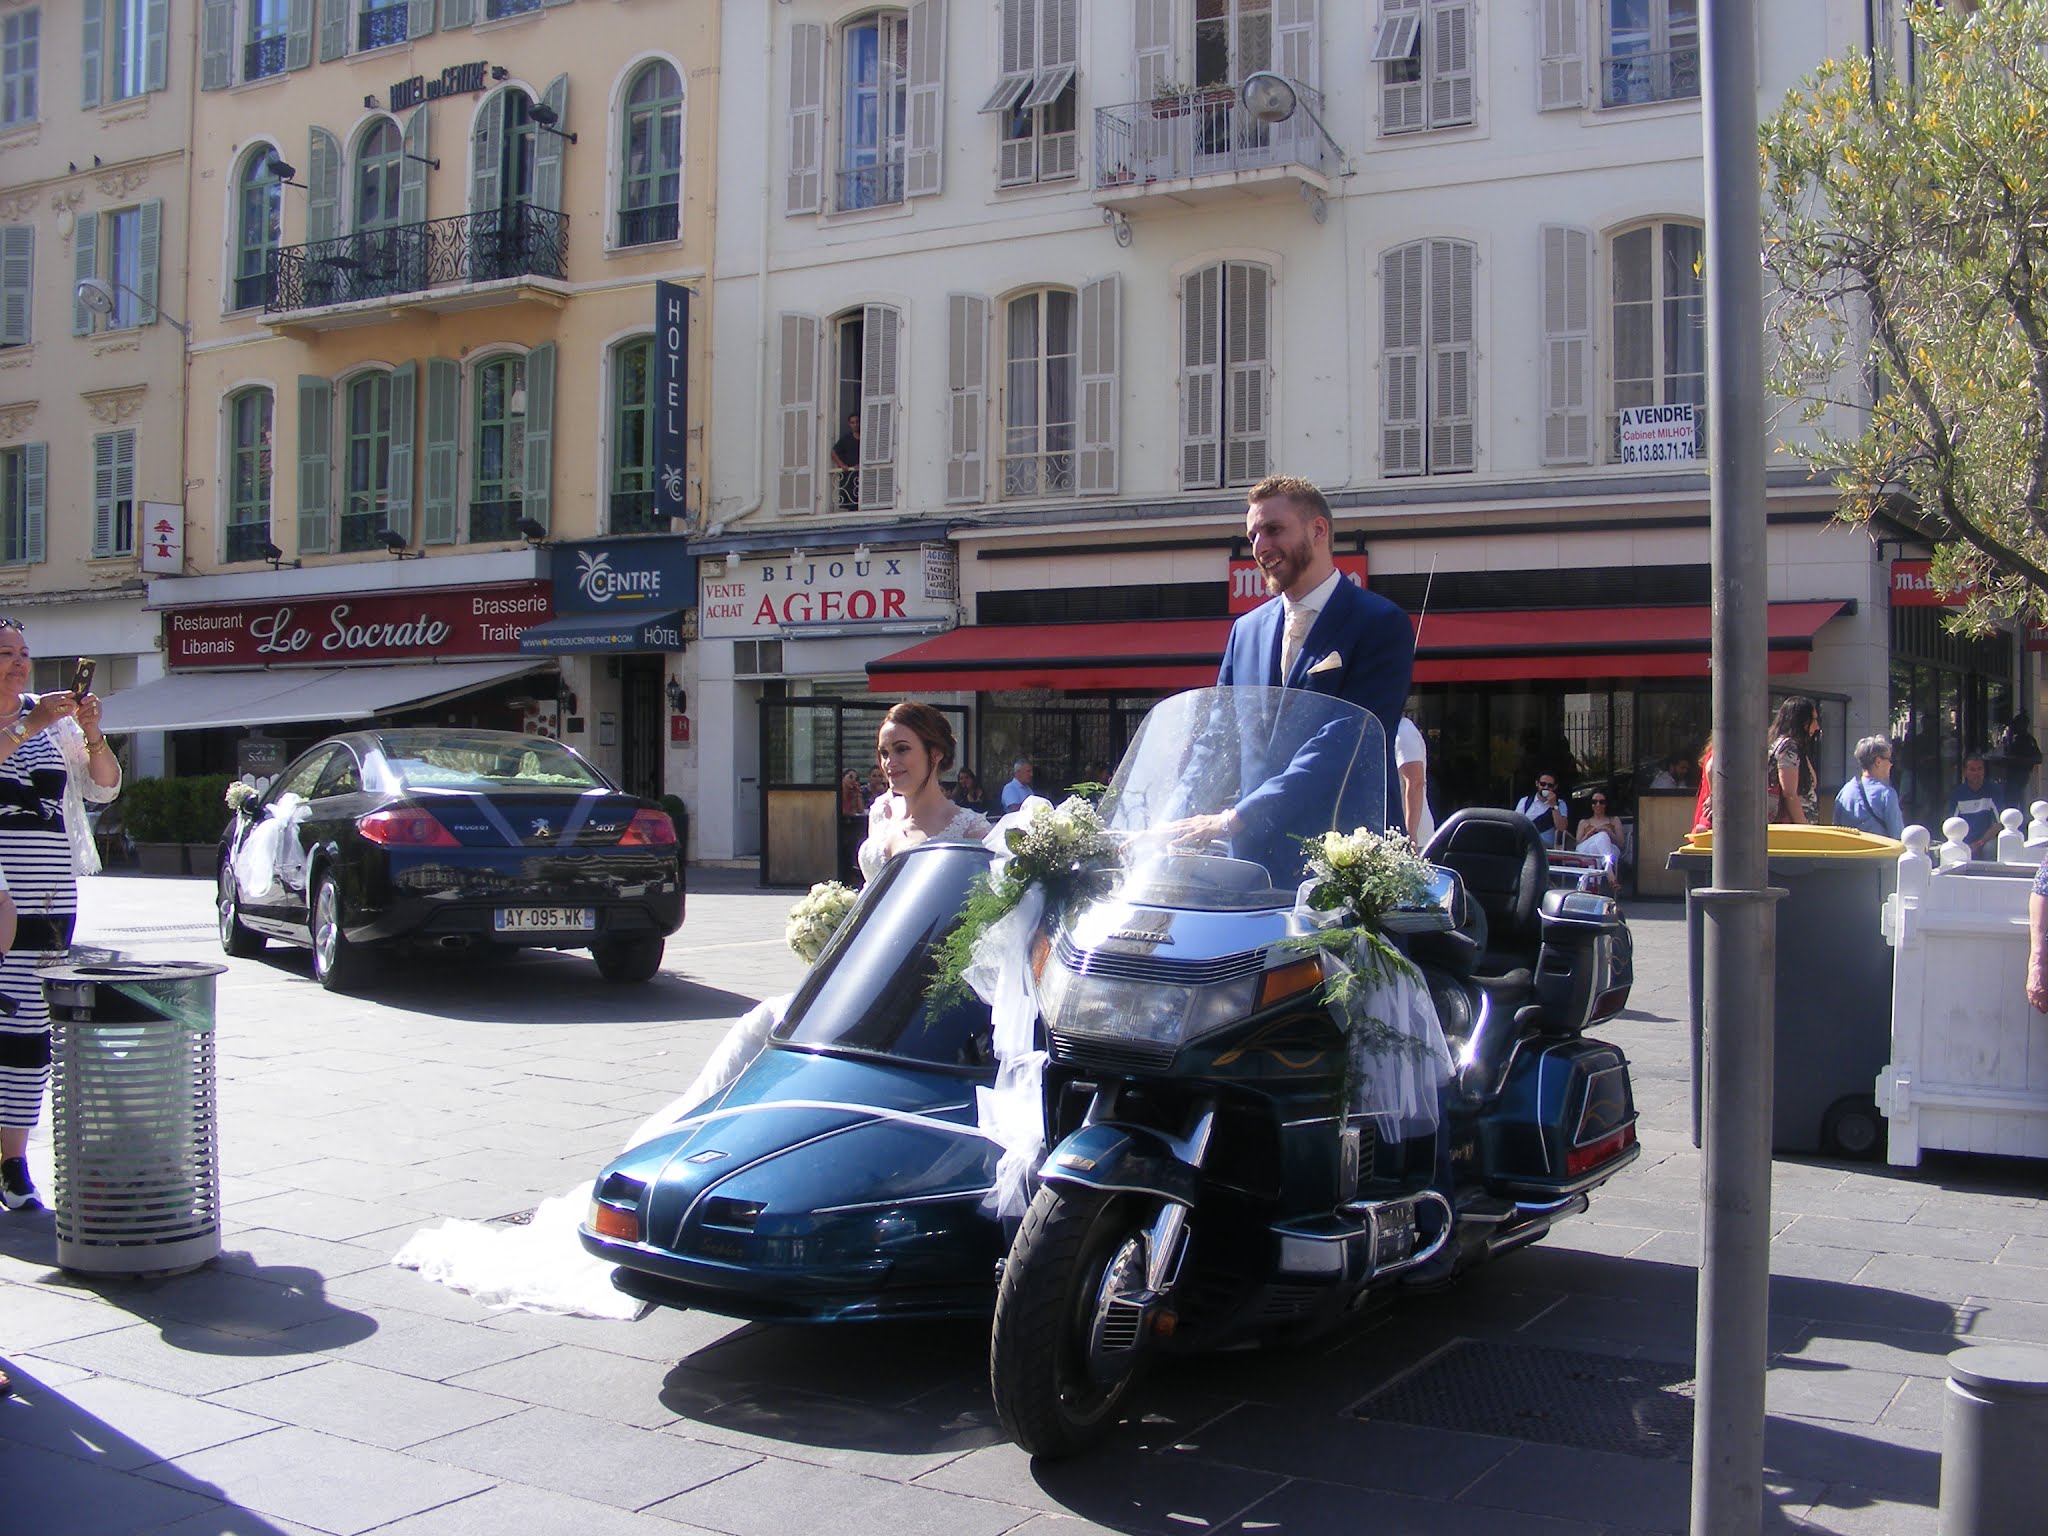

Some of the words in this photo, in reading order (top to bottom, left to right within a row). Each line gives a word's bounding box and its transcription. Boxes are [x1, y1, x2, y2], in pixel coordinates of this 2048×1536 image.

[390, 75, 424, 113] HOTEL
[441, 60, 488, 97] CENTRE
[668, 298, 680, 435] HOTEL
[1622, 410, 1632, 426] A
[1635, 405, 1693, 425] VENDRE
[1623, 430, 1656, 441] Cabinet
[1657, 426, 1691, 438] MILHOT
[1623, 441, 1694, 463] 06.13.83.71.74
[762, 559, 901, 585] BIJOUX
[929, 566, 951, 576] ACHAT
[586, 570, 661, 602] CENTRE
[706, 584, 746, 598] VENTE
[472, 595, 548, 616] Brasserie
[705, 603, 745, 619] ACHAT
[752, 588, 908, 626] AGEOR
[174, 612, 243, 631] Restaurant
[250, 607, 311, 653] Le
[321, 604, 450, 651] Socrate
[479, 623, 534, 641] Traite
[182, 637, 235, 655] Libanais
[644, 625, 679, 646] HÔTEL
[596, 824, 615, 832] 407
[506, 909, 582, 927] AY-095-WK
